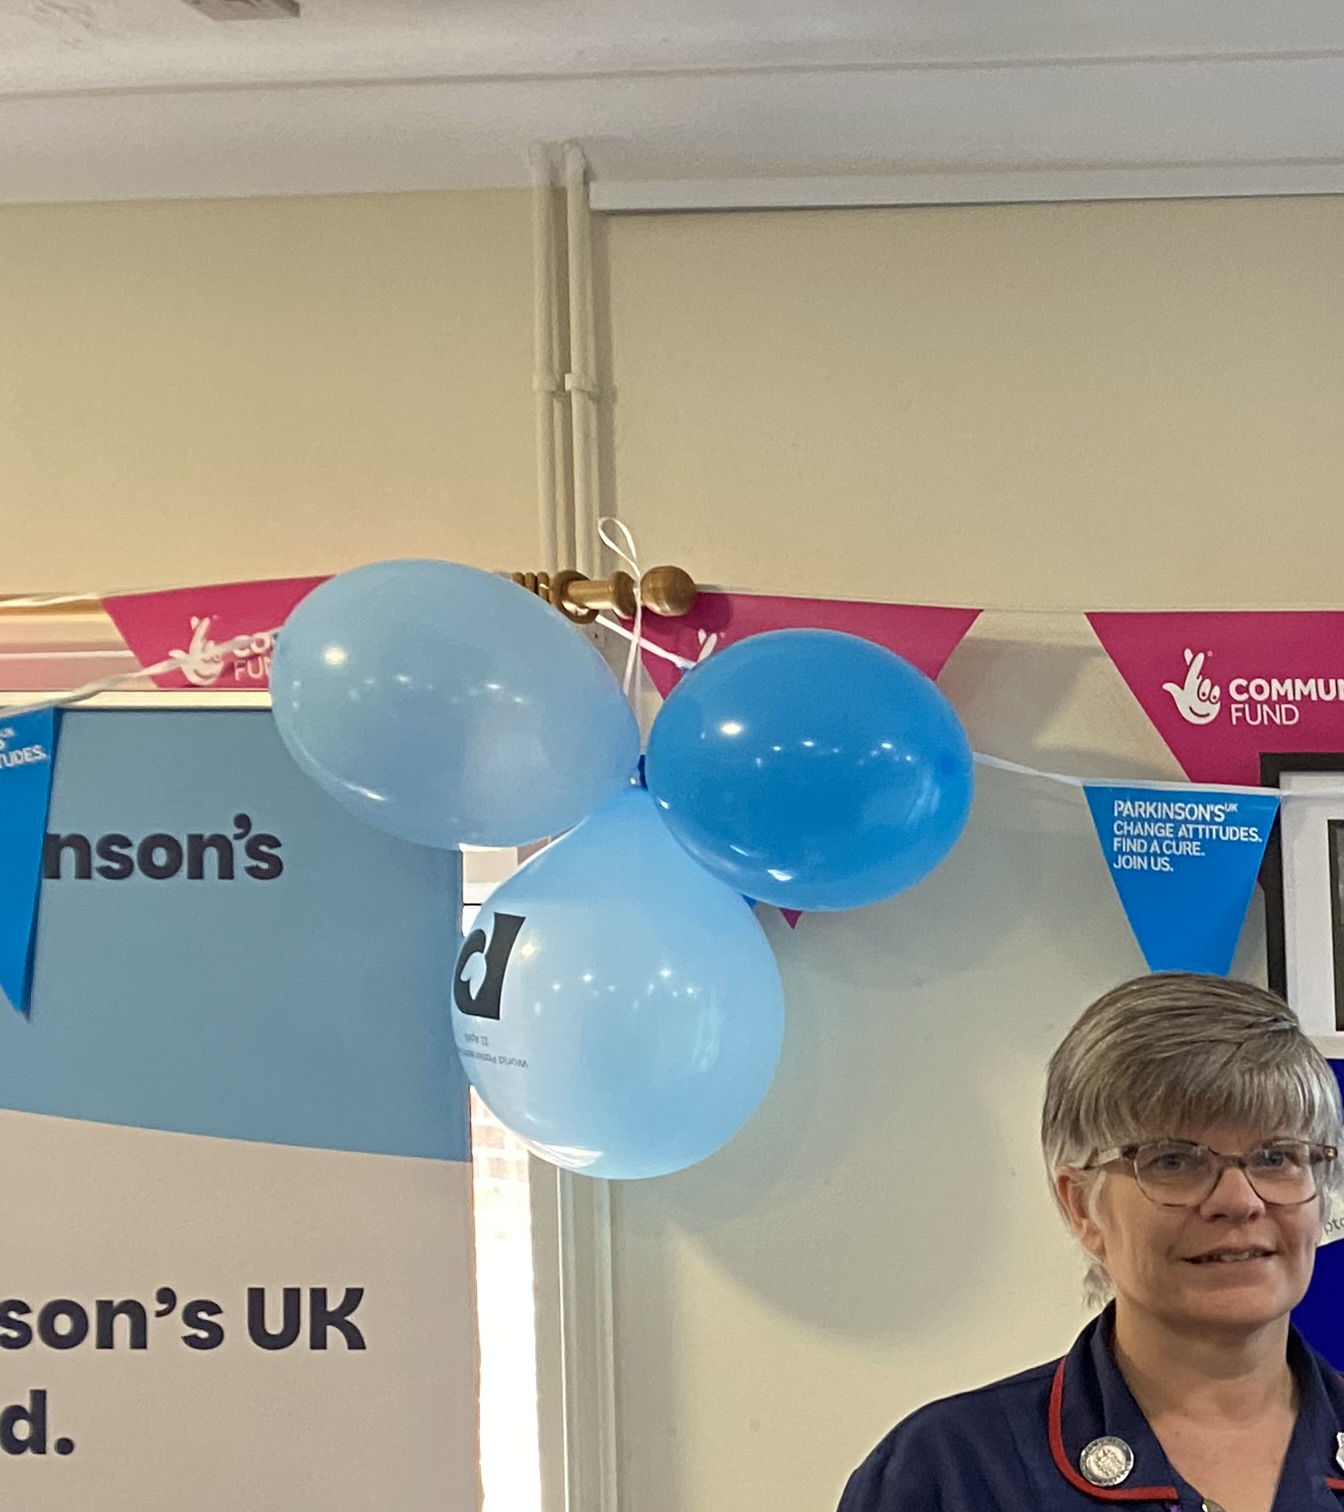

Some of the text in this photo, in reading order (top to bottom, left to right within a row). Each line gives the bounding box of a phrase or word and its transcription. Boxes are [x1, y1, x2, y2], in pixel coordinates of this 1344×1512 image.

[1230, 703, 1300, 727] FUND
[1114, 800, 1225, 822] PARKINSON'S
[1113, 821, 1262, 842] CHANGE ATTITUDES.
[44, 813, 285, 882] nson's
[1113, 838, 1205, 856] FIND CURE.
[1113, 855, 1174, 872] JOIN US.
[247, 1286, 367, 1351] UK
